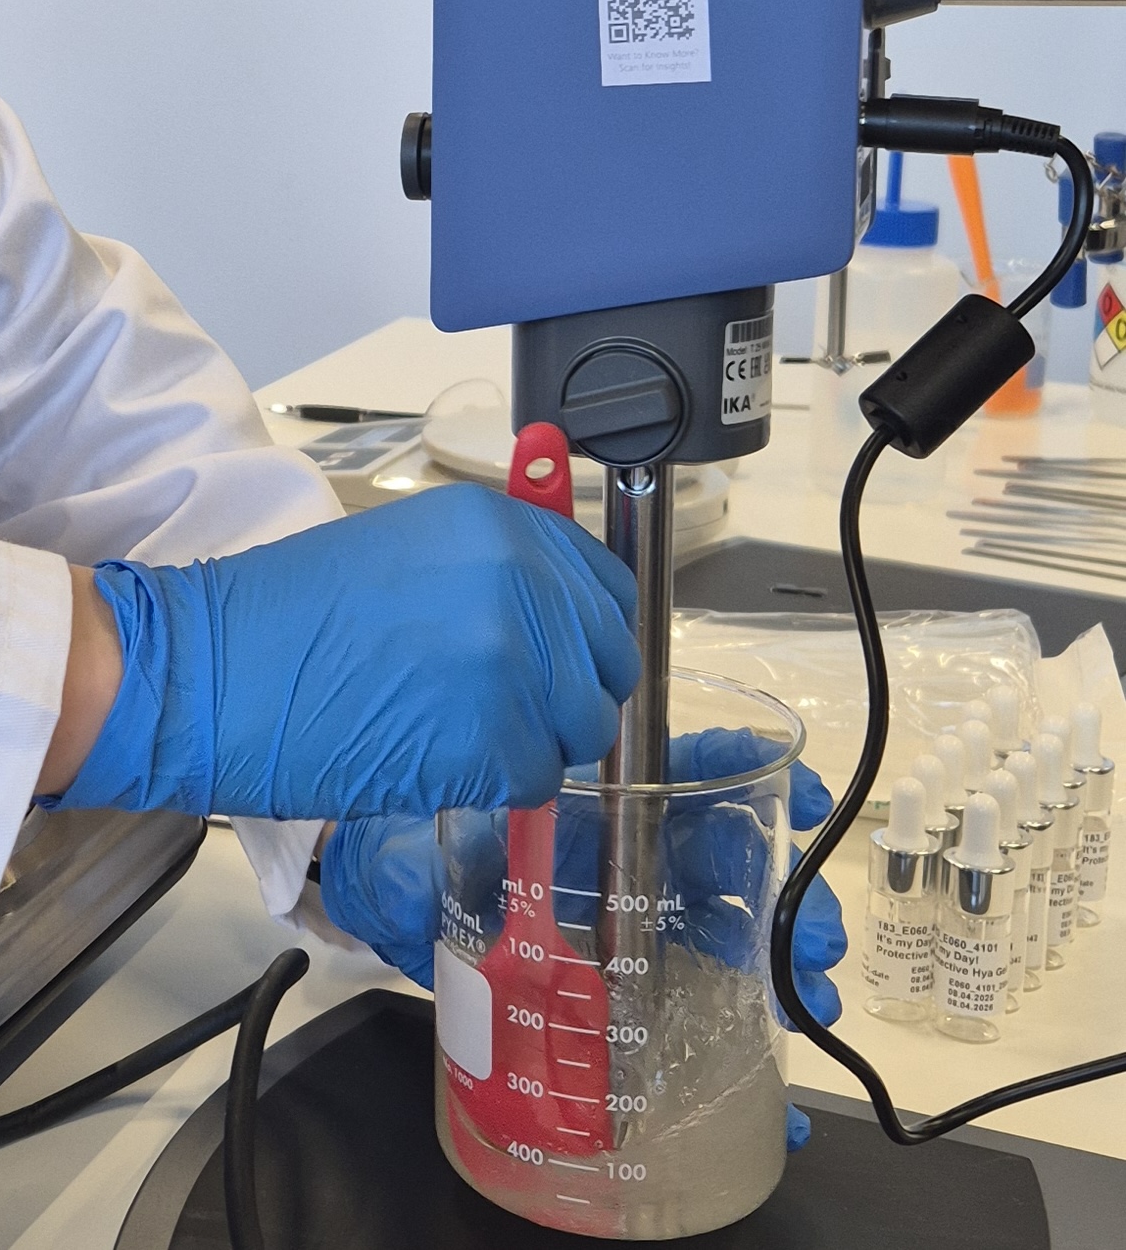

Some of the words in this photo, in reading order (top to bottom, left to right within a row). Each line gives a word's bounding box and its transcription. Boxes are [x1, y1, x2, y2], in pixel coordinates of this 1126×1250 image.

[1103, 294, 1113, 317] 0
[723, 394, 751, 414] IKA
[502, 878, 527, 897] mL
[530, 883, 544, 901] 0
[606, 894, 649, 913] 500
[656, 894, 685, 912] mL
[640, 915, 685, 932] ±5%
[509, 937, 545, 962] 100
[876, 932, 892, 945] It's
[895, 939, 913, 949] my
[916, 937, 934, 948] Day
[876, 945, 929, 960] Protective
[953, 950, 979, 966] Day!
[605, 957, 649, 975] 400
[972, 968, 993, 980] Hya
[507, 1005, 544, 1030] 200
[605, 1025, 648, 1044] 300
[454, 1067, 473, 1090] 1000
[507, 1072, 544, 1098] 300
[605, 1093, 647, 1113] 200
[507, 1140, 544, 1166] 400
[606, 1162, 646, 1181] 100
